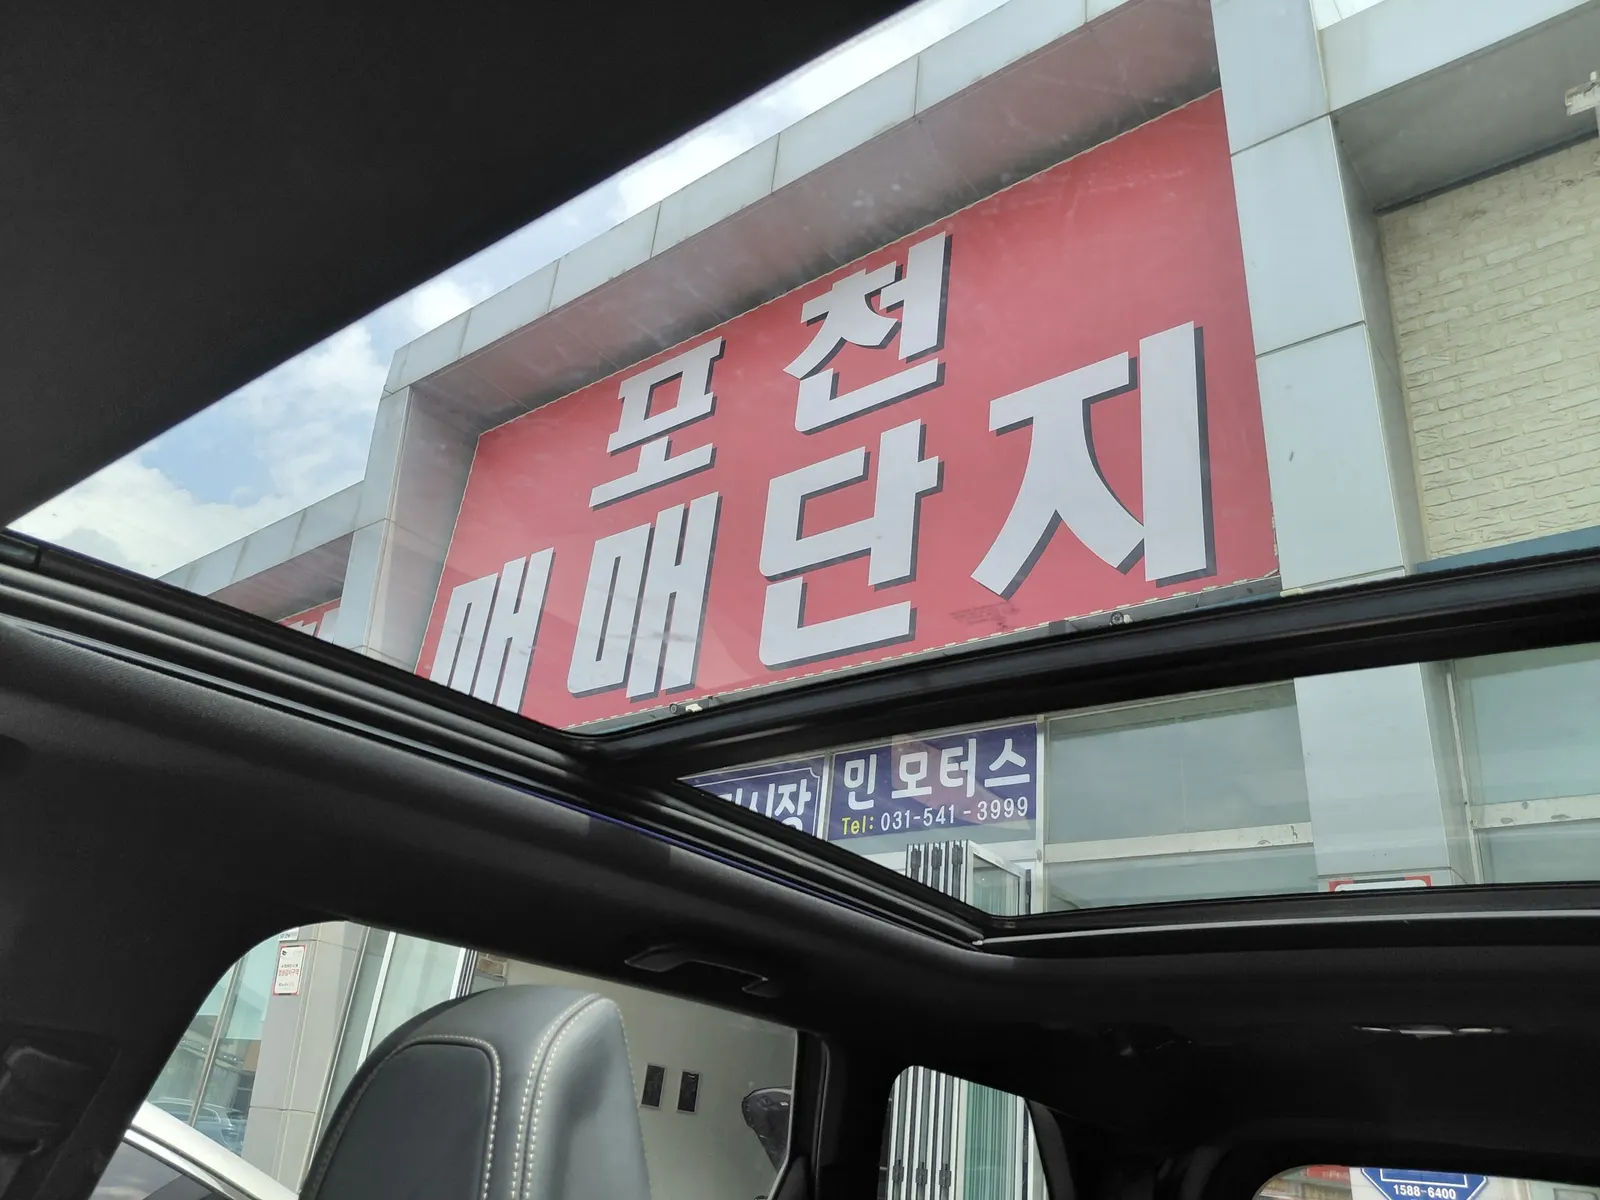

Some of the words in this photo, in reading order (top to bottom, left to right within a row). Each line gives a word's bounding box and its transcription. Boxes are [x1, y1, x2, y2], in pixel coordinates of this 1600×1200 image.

[430, 321, 1211, 712] 매매단지
[843, 753, 878, 810] 민
[891, 738, 1031, 799] 모터스
[717, 778, 812, 832] 시장
[841, 815, 874, 836] Tel:
[1392, 1184, 1457, 1200] 1588-6400
